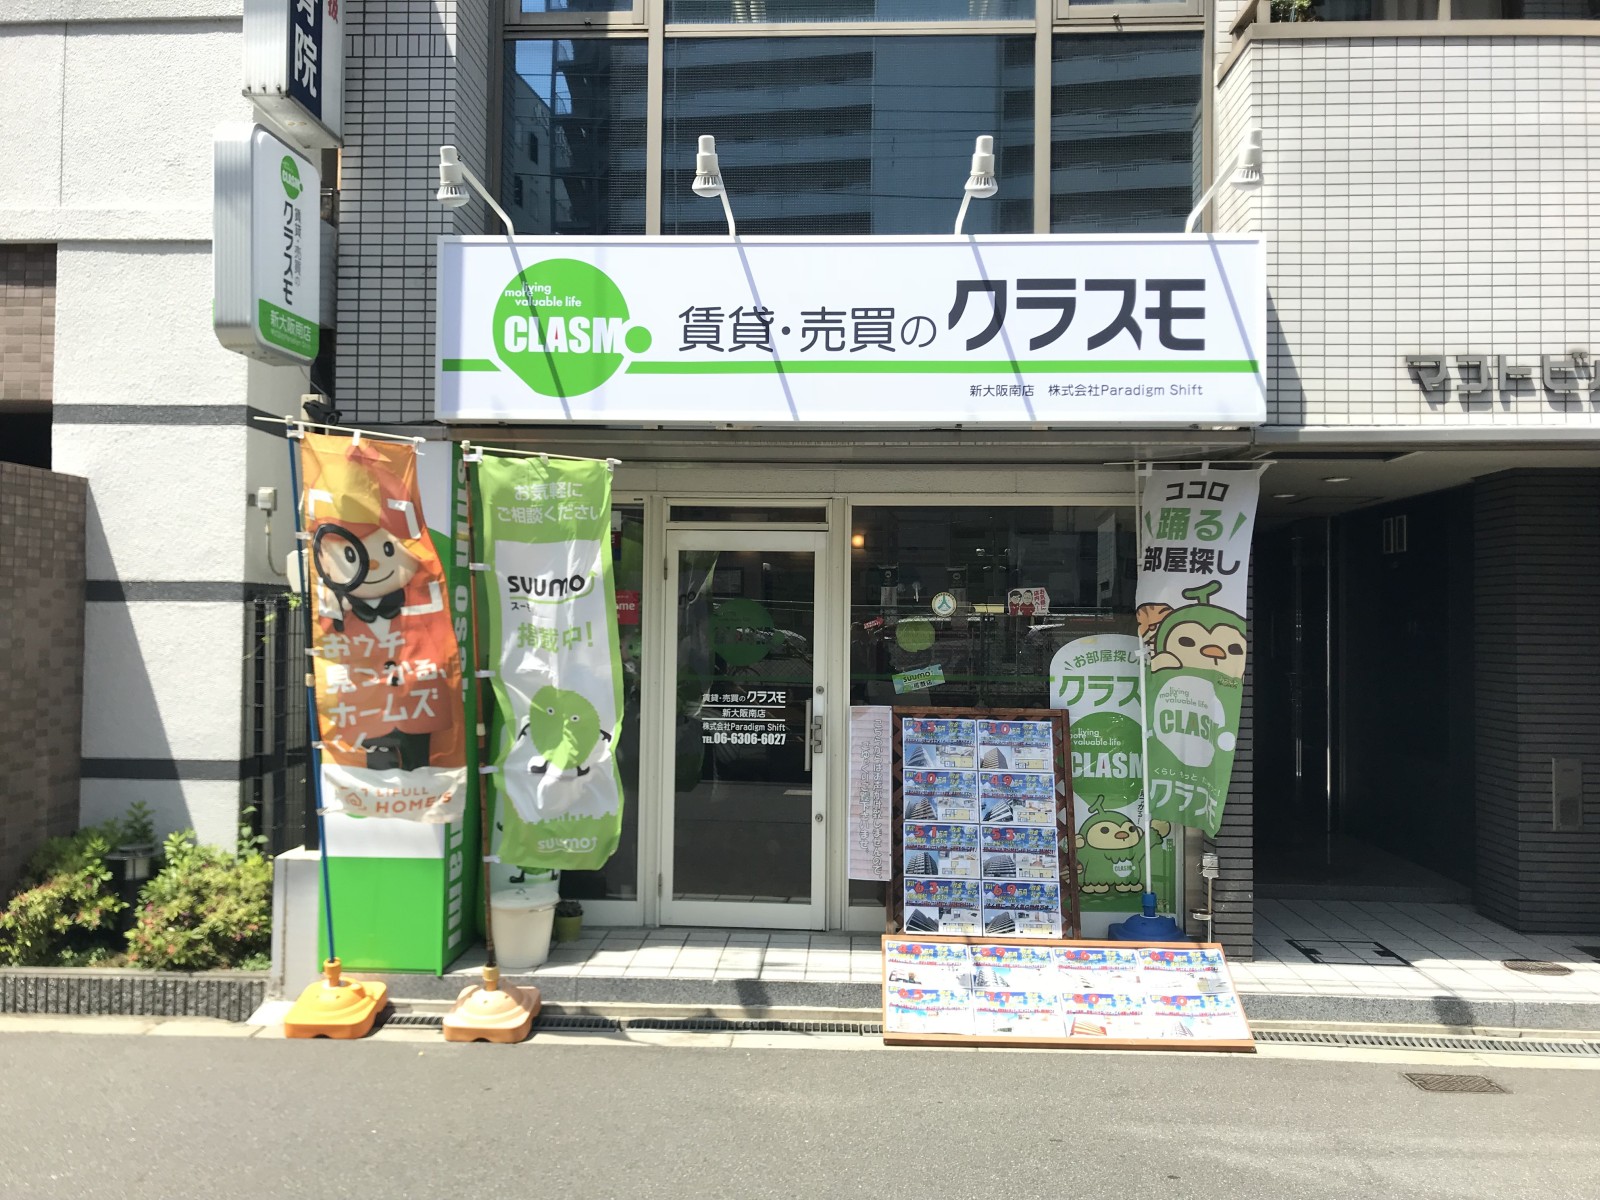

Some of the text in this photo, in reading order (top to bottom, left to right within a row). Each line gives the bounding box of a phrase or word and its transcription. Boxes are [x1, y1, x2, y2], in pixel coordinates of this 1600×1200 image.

[282, 200, 294, 306] クラスモ
[504, 288, 534, 298] more
[522, 281, 552, 295] living
[514, 296, 582, 307] valuable life
[969, 383, 1204, 398] 新大阪南店 株式会社Paradigm Shift
[513, 481, 584, 502] お気軽に
[1165, 480, 1231, 502] ココロ
[496, 504, 601, 525] ご相談ください
[1155, 507, 1224, 542] 踊る
[1142, 545, 1241, 576] 部屋探し
[328, 688, 439, 728] ホームズ
[721, 708, 767, 718] 新大阪南店
[767, 723, 786, 732] Shift
[1073, 738, 1108, 746] valuable
